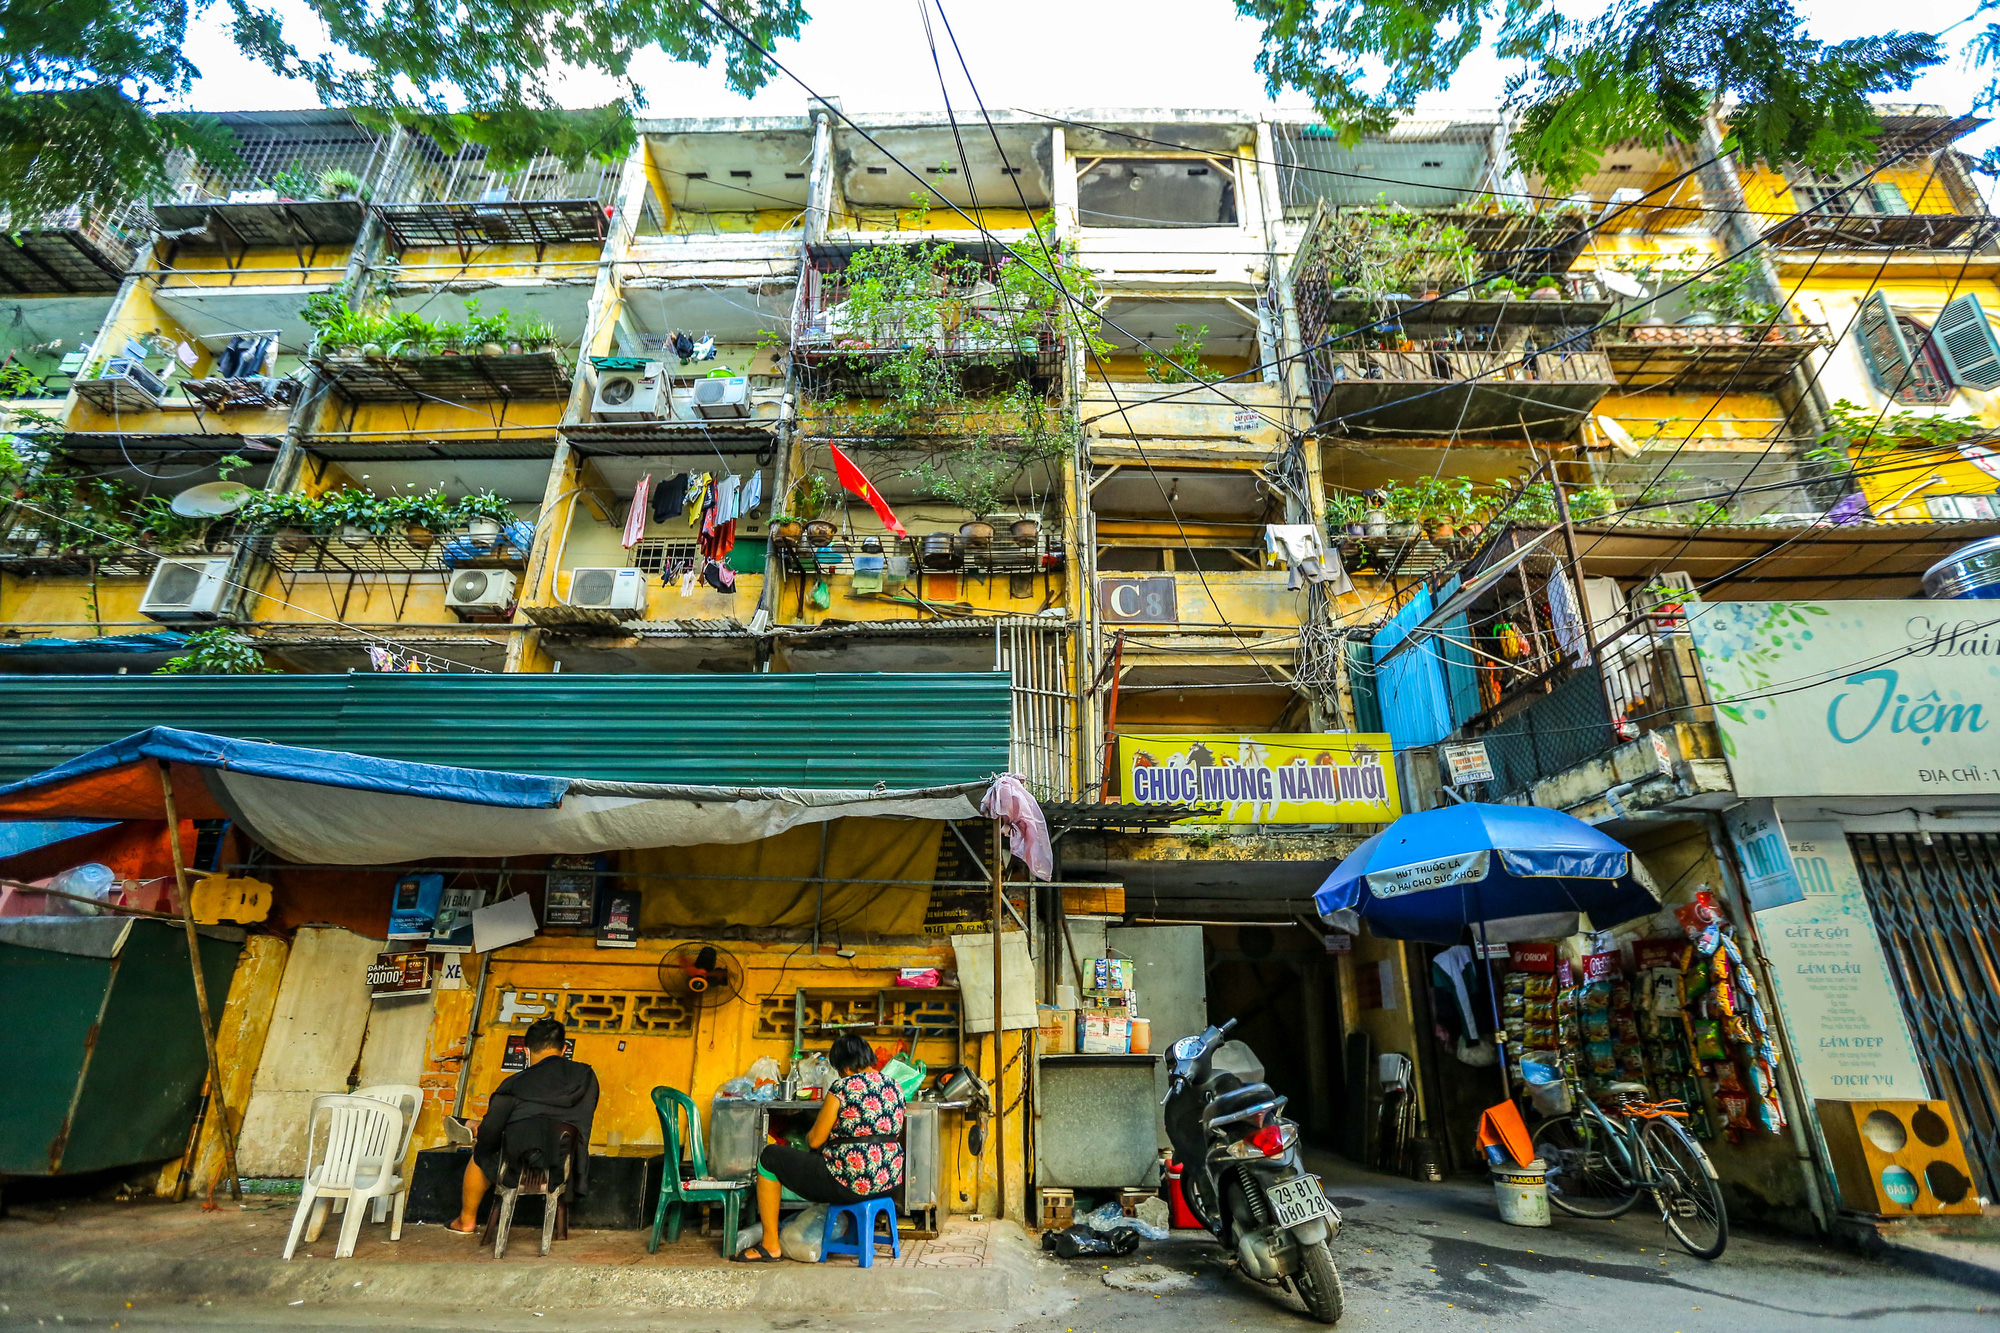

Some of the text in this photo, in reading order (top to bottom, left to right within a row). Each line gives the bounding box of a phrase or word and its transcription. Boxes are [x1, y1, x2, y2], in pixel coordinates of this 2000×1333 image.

[1827, 669, 1989, 746] Tiệm
[1134, 754, 1386, 801] CHÚC MỪNG NĂM MỚI
[1918, 769, 1950, 785] ĐỊA
[1737, 833, 1786, 880] LOAN
[1396, 858, 1461, 879] HÚT THUỐC LÁ
[1383, 884, 1397, 895] CÓ
[1412, 877, 1432, 888] CHO
[1434, 873, 1453, 884] SỨC
[1454, 867, 1481, 881] KHỎE
[443, 896, 452, 907] VỊ
[924, 926, 944, 934] Wifi
[1785, 925, 1850, 940] CẮT & GỘI
[1523, 952, 1548, 962] ORION
[445, 964, 461, 979] XE
[1796, 962, 1861, 975] LÀM ĐẦU
[1819, 1036, 1884, 1049] LÀM ĐẸP
[1830, 1073, 1895, 1088] DỊCH VỤ
[1509, 1175, 1545, 1185] MAXILITE
[1274, 1179, 1314, 1206] 29-B1
[1886, 1183, 1907, 1196] ĐÀO
[1278, 1195, 1327, 1225] 080.28
